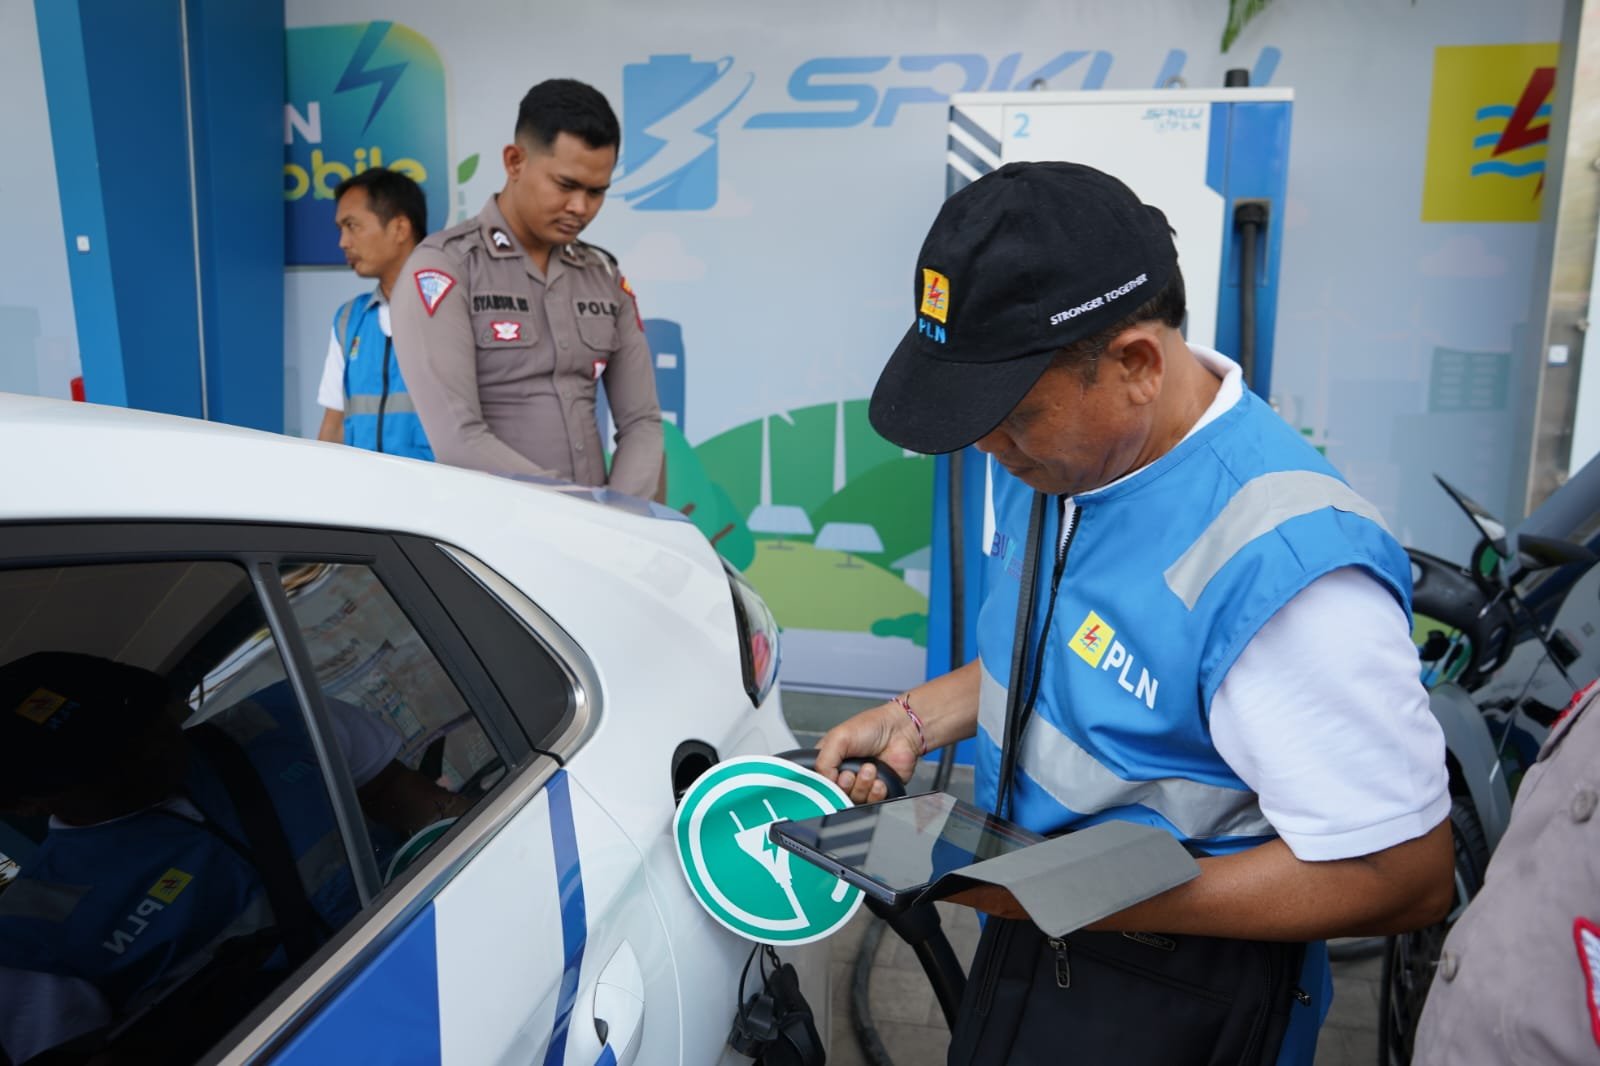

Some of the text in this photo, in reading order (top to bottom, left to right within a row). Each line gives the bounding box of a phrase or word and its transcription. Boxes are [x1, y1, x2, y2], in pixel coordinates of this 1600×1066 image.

[1012, 111, 1031, 139] 2
[1050, 272, 1148, 325] STRONGER TOGETHER
[918, 317, 947, 344] PLN
[1101, 639, 1159, 710] PLN
